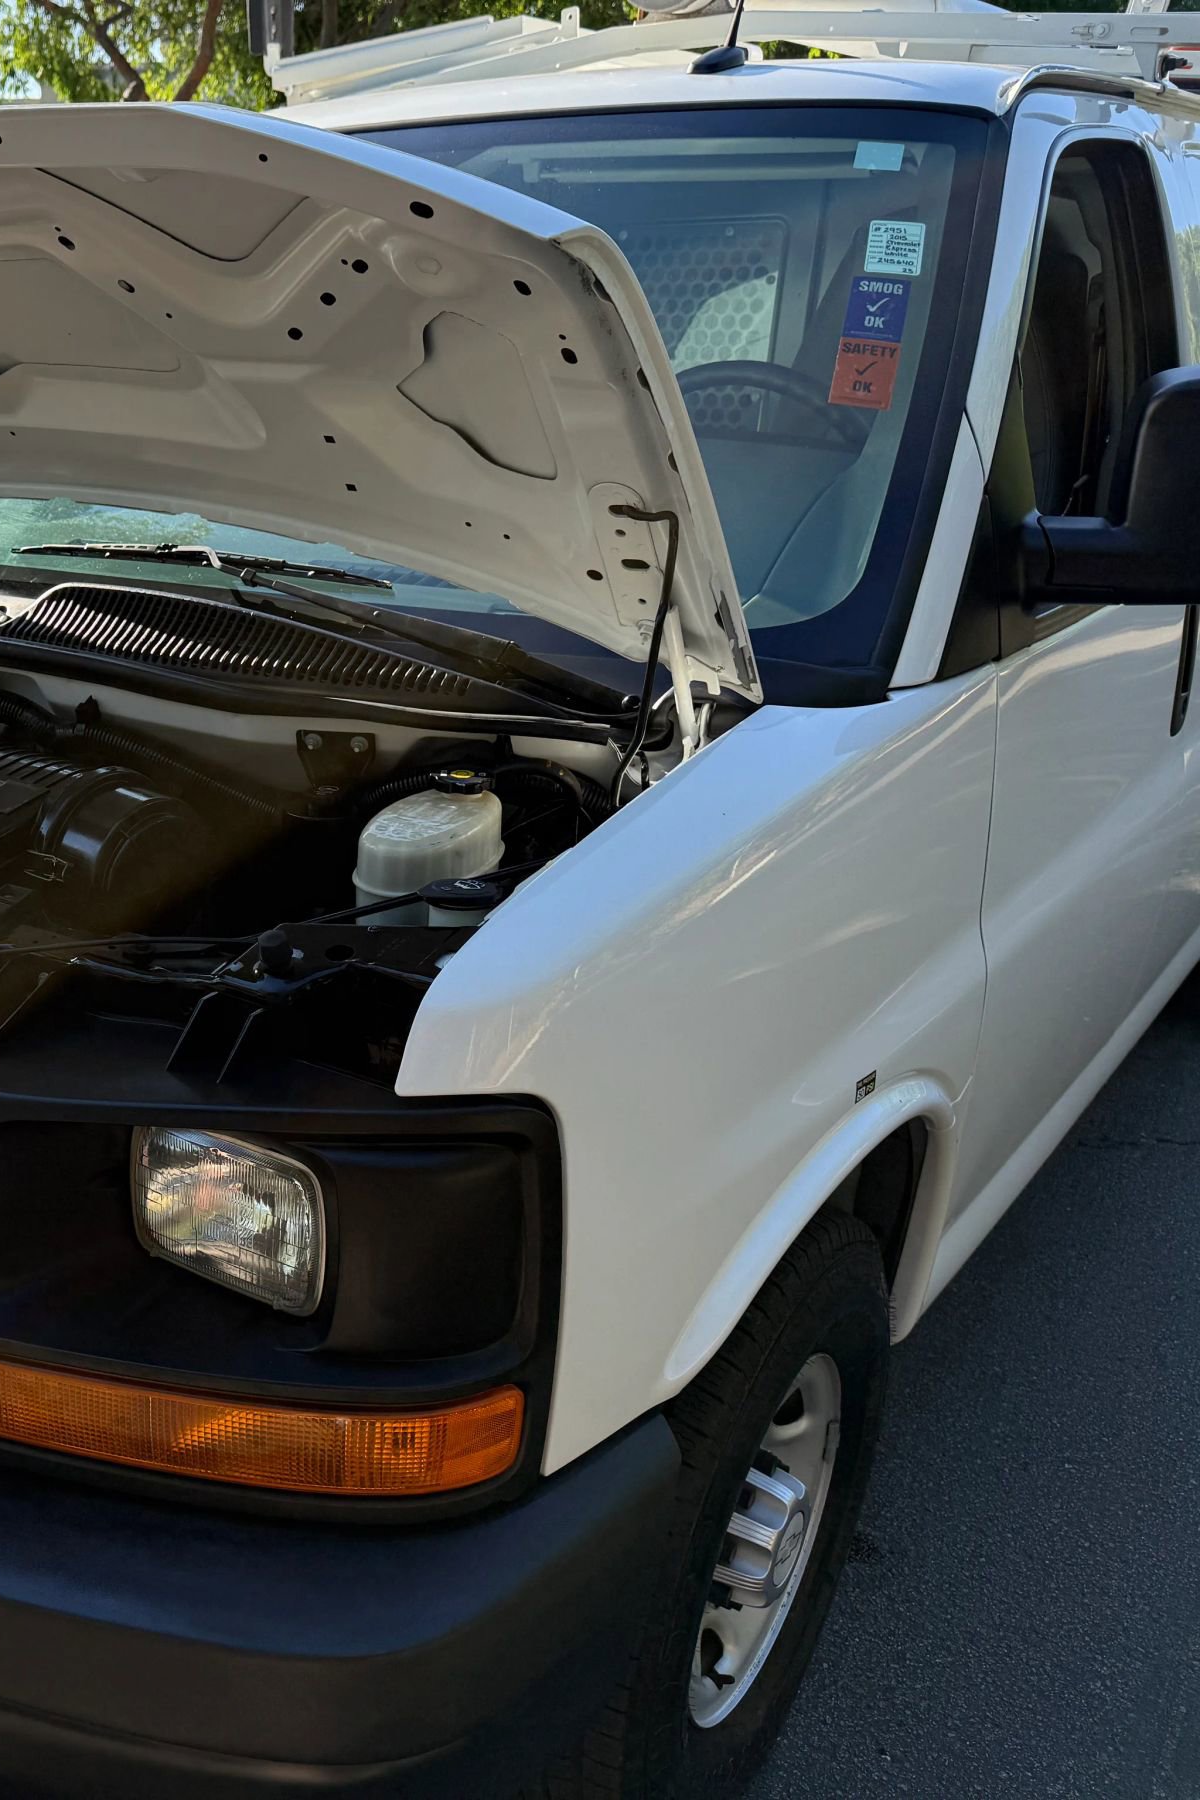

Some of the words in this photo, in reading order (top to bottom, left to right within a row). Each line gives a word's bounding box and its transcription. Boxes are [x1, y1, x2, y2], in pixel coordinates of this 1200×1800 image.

[858, 280, 904, 296] SMOG
[864, 315, 885, 329] OK
[841, 342, 898, 359] SAFETY
[852, 381, 872, 394] OK
